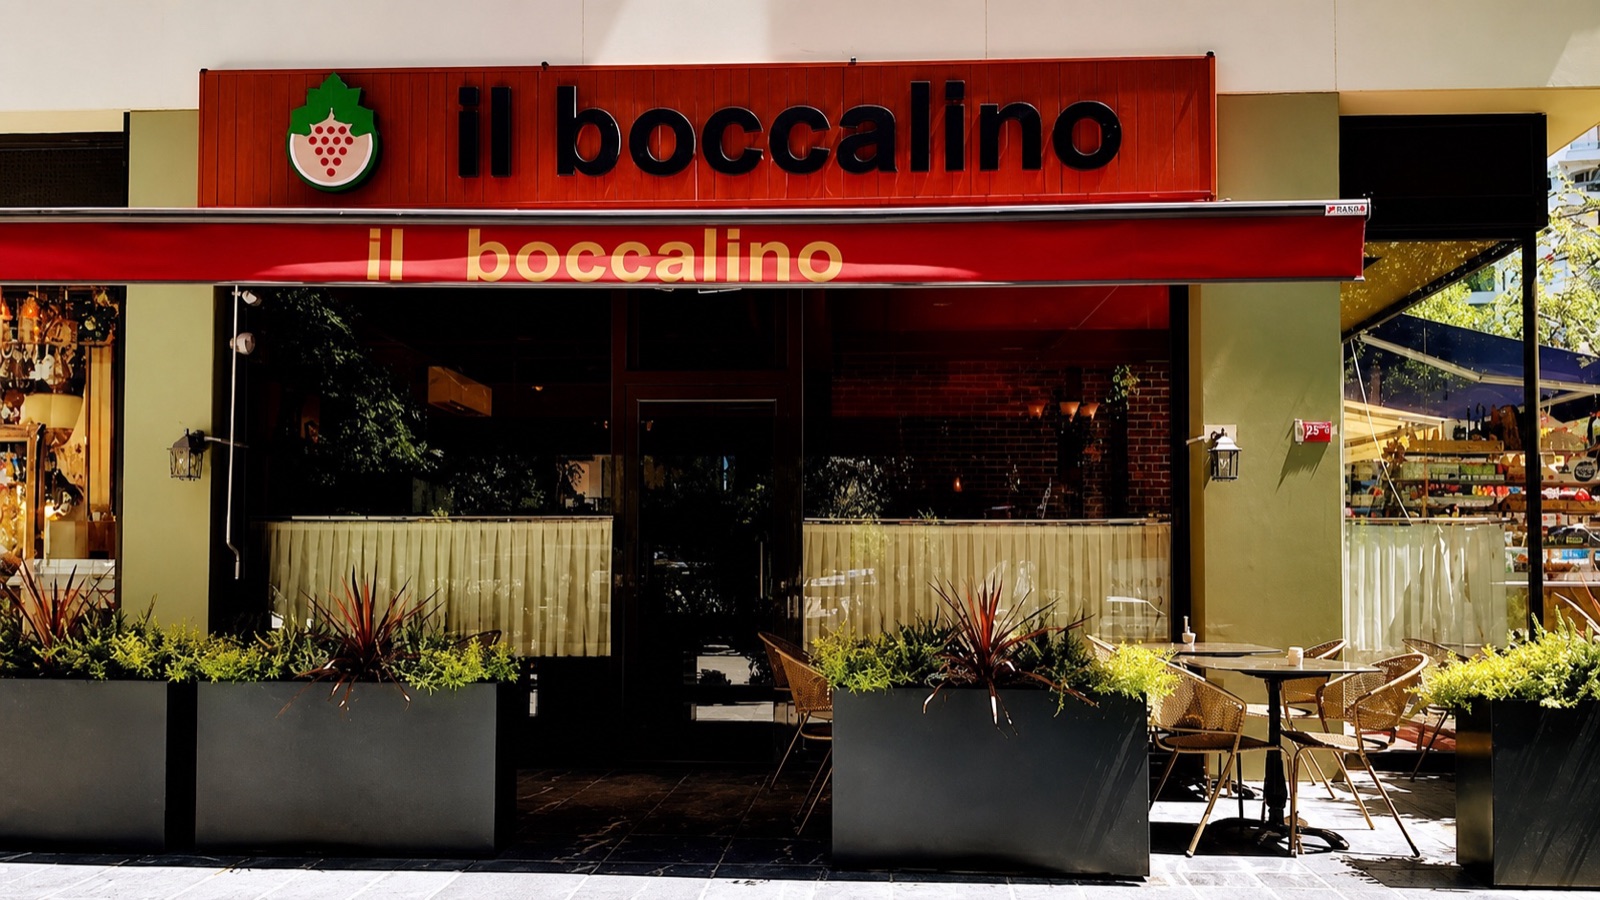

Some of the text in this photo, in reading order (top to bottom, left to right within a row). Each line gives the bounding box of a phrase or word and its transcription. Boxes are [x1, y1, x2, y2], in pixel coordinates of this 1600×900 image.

[458, 80, 1122, 177] il boccalino
[366, 228, 843, 282] il boccalino
